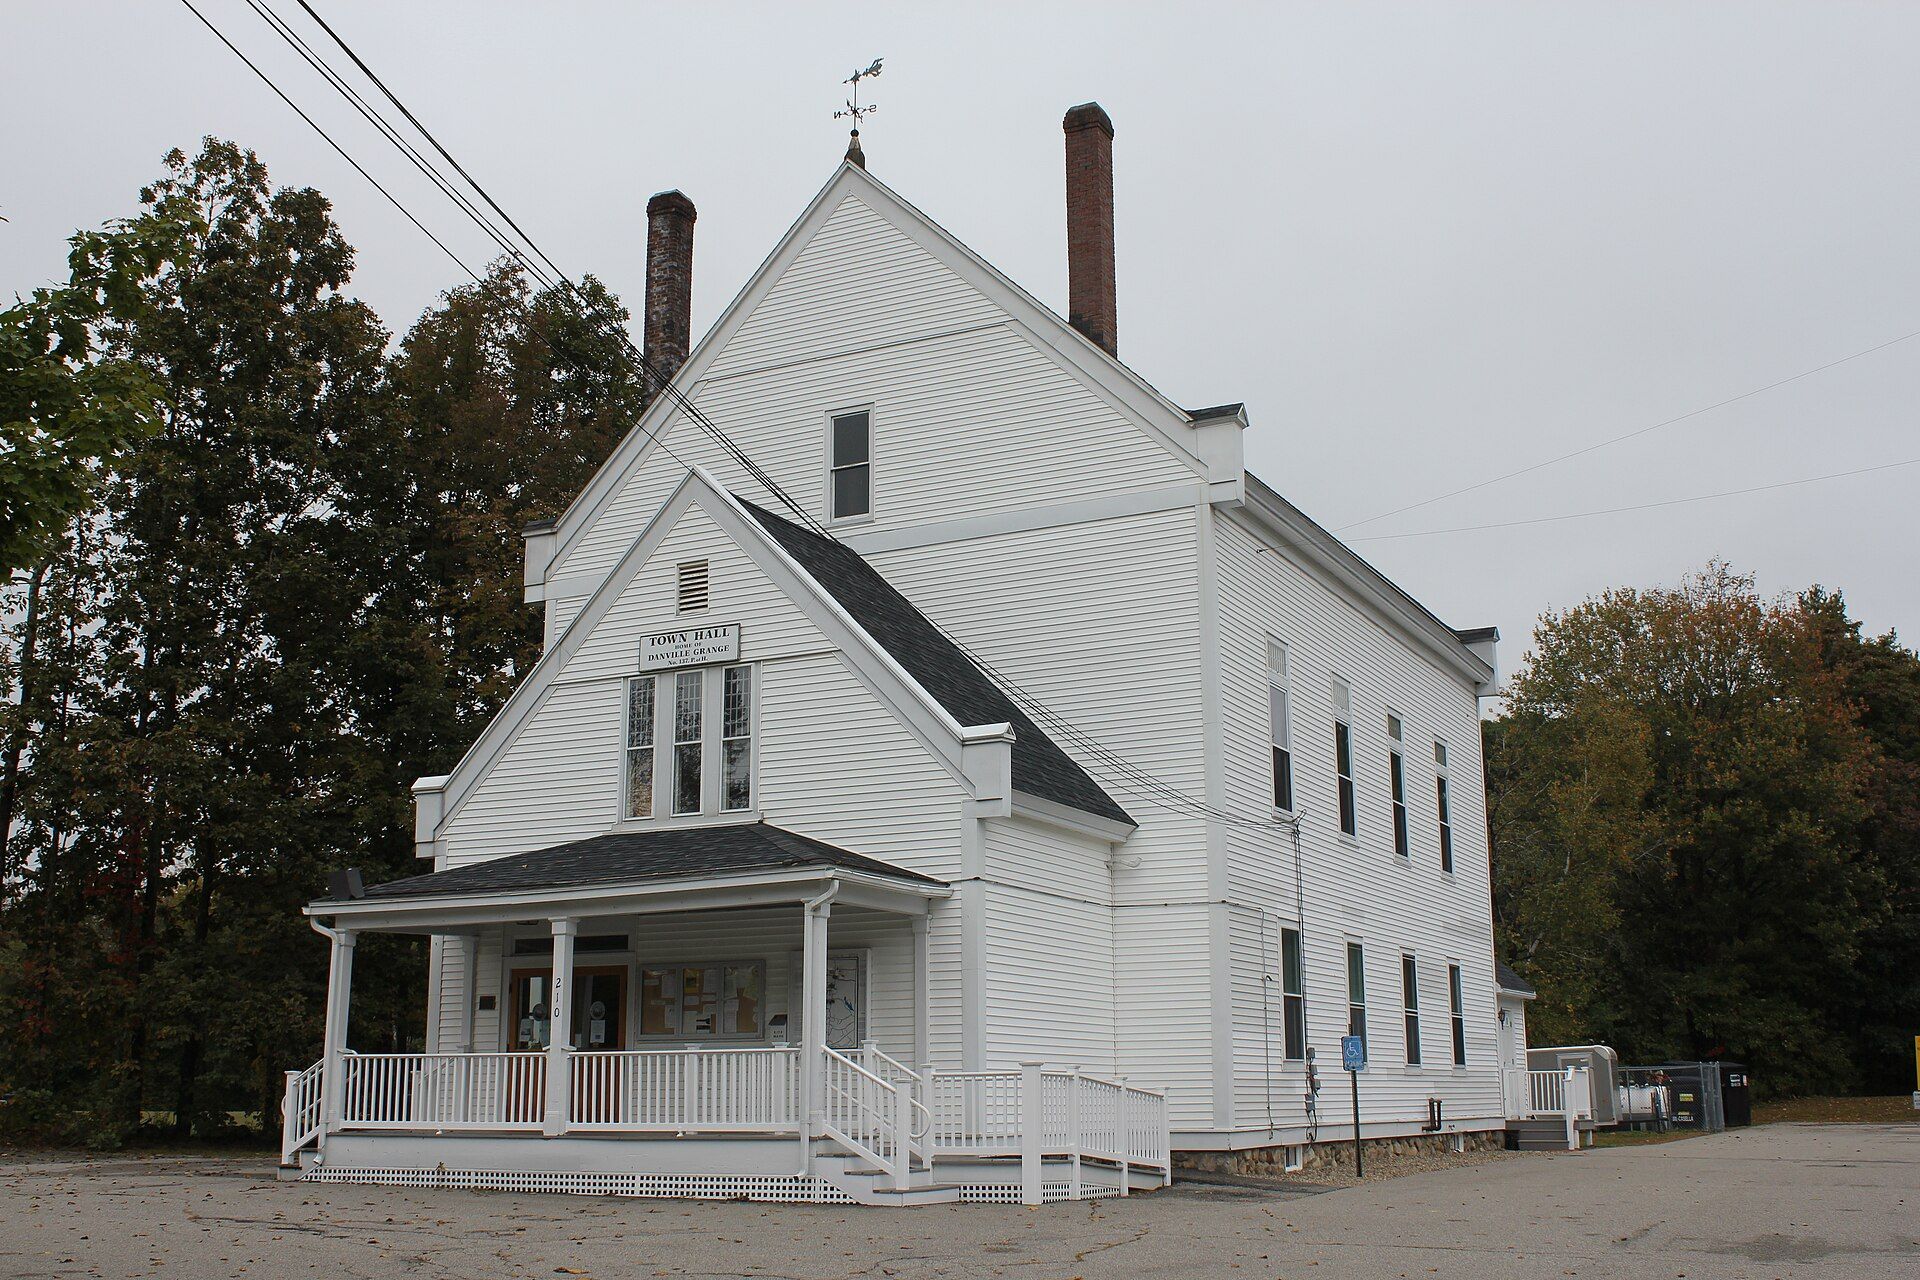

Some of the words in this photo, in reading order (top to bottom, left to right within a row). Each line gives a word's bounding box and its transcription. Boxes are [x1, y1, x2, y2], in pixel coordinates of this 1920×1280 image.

[650, 633, 688, 646] TOWN
[694, 628, 730, 640] HALL
[648, 650, 690, 661] DANVILLE
[693, 645, 730, 655] GRANGE
